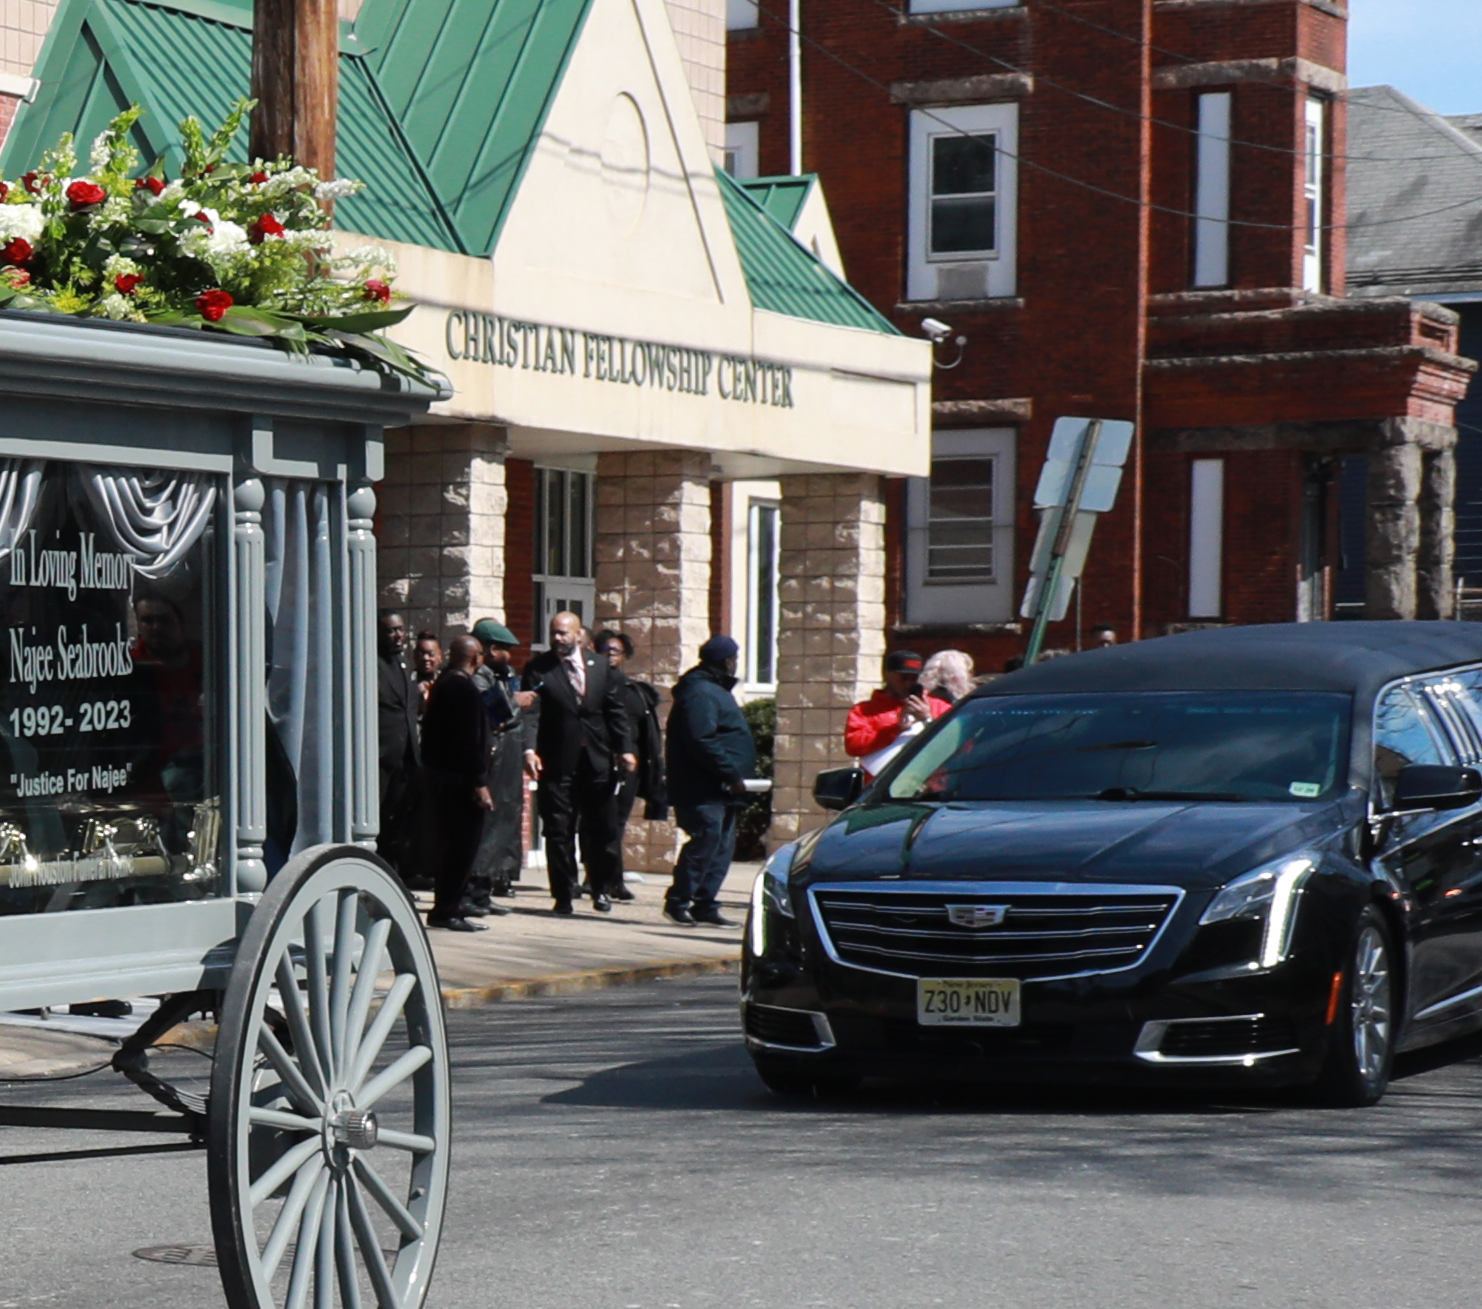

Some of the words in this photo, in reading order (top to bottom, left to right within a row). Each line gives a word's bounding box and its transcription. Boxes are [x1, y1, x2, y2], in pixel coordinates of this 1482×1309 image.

[445, 310, 576, 375] CHRISTIAN
[583, 332, 713, 396] FELLOWSHIP
[717, 354, 795, 408] CENTER
[10, 528, 26, 586] In
[29, 529, 77, 602] Loving
[79, 531, 136, 604] Memory
[9, 626, 54, 694] Najee
[57, 622, 134, 680] Seabrooks
[9, 704, 74, 738] 1992-
[79, 699, 132, 732] 2023
[10, 771, 64, 798] "Justice
[67, 767, 90, 793] For
[92, 762, 132, 794] Najee"
[924, 990, 961, 1013] Z30
